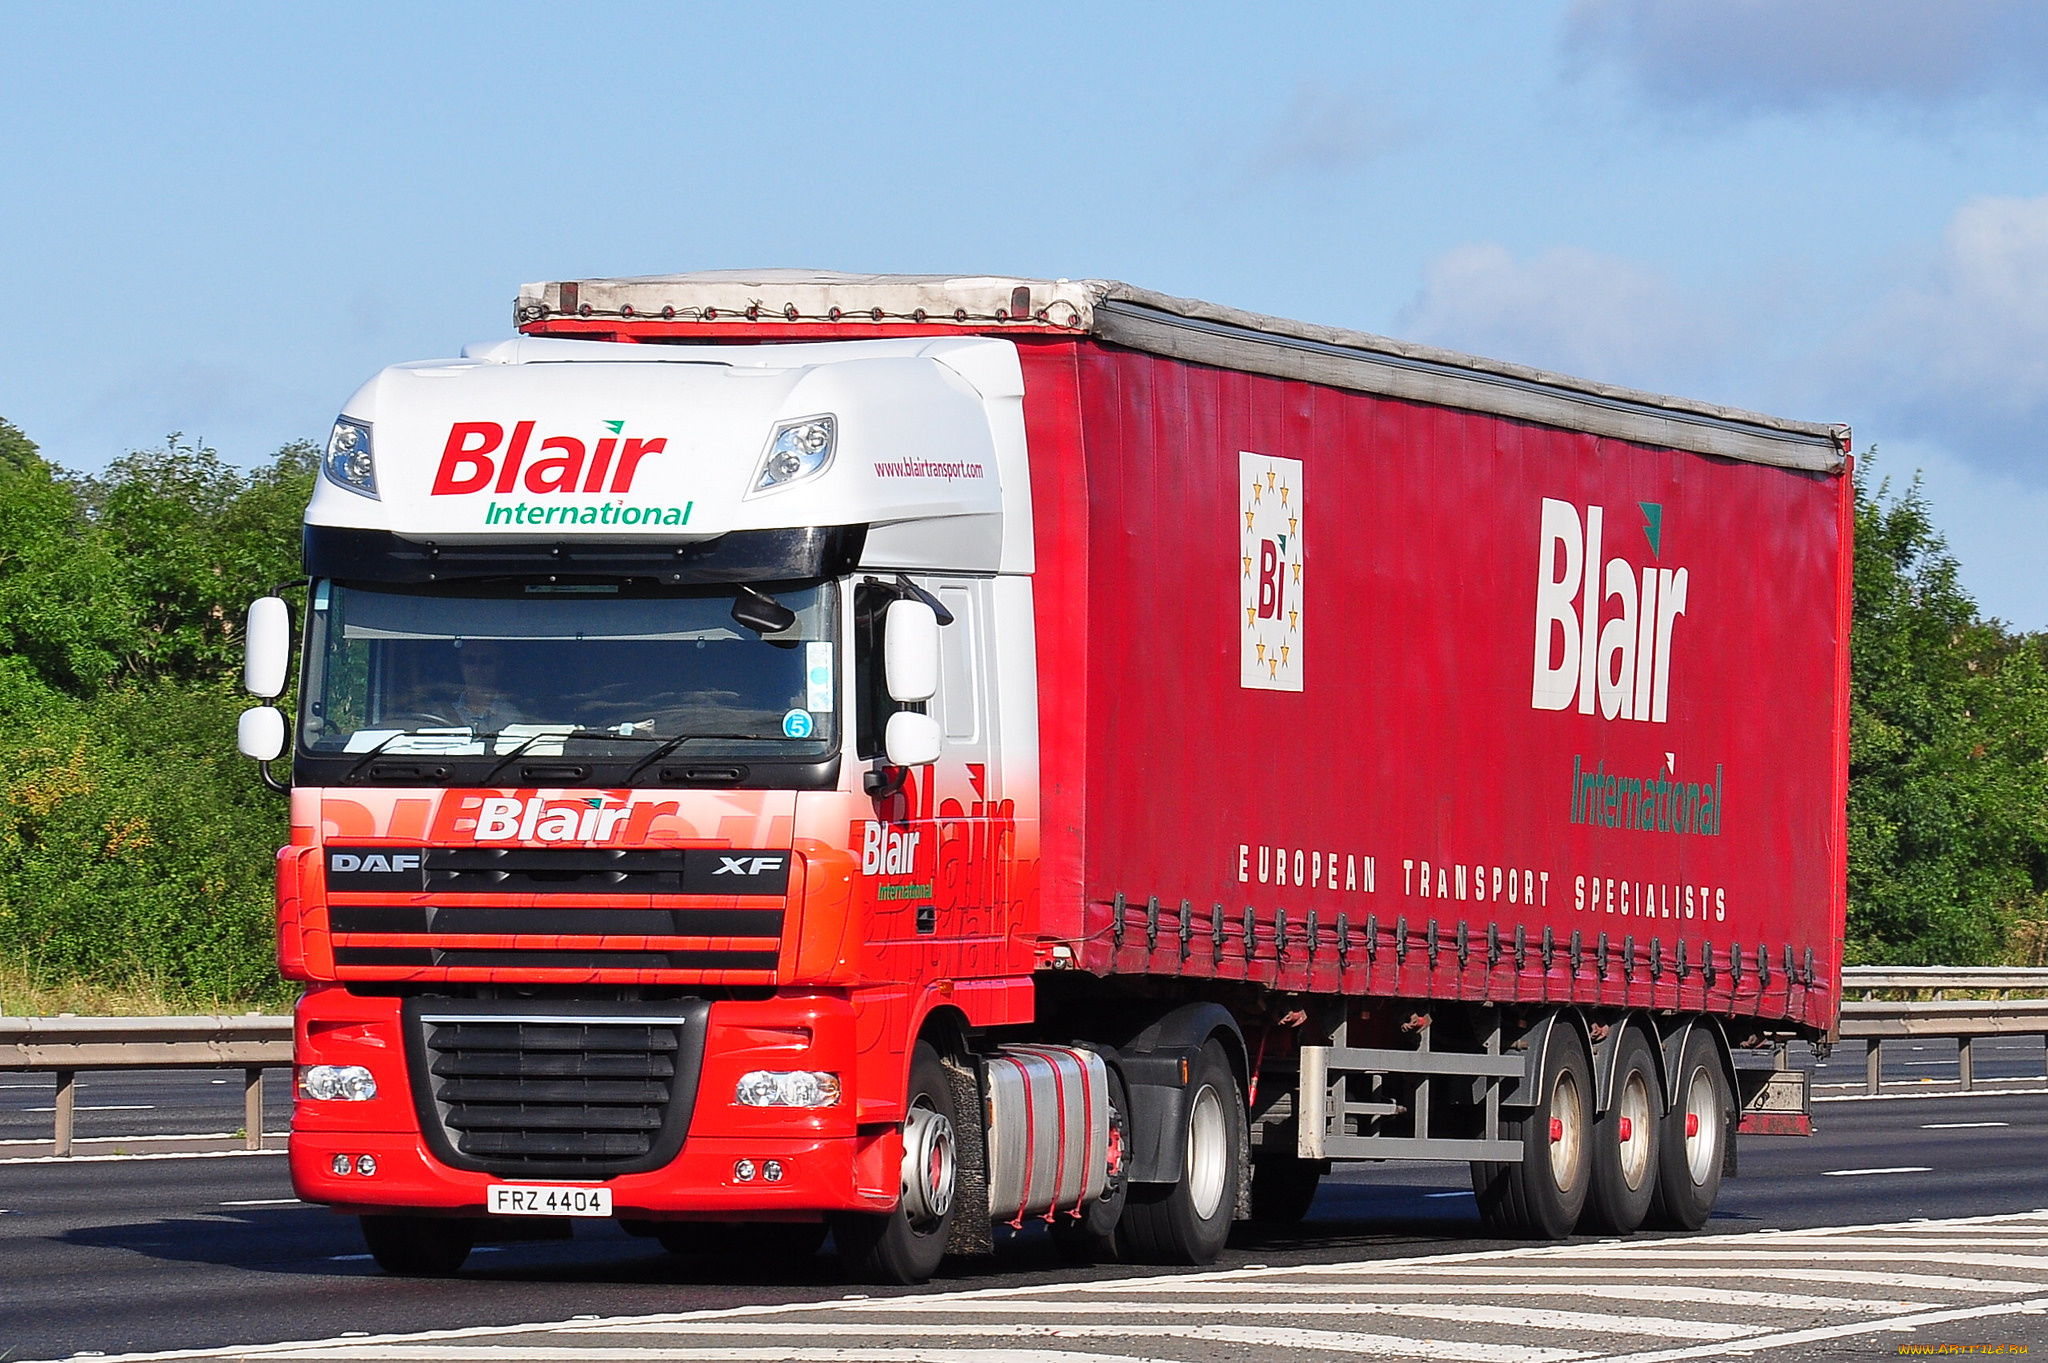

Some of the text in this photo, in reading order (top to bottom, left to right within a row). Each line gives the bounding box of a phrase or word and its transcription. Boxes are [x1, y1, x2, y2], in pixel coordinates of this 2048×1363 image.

[431, 420, 668, 496] Blair
[874, 456, 984, 482] www.blairtransport.com
[485, 500, 694, 526] International
[1532, 497, 1688, 723] Blair
[1570, 753, 1722, 836] International
[474, 797, 632, 842] Blair
[331, 854, 421, 873] DAF
[711, 856, 784, 875] XF
[862, 820, 920, 876] Blair
[877, 878, 934, 901] International
[1239, 844, 1726, 922] EUROPEAN TRANSPORT SPECIALISTS
[498, 1190, 601, 1212] FRZ 4404
